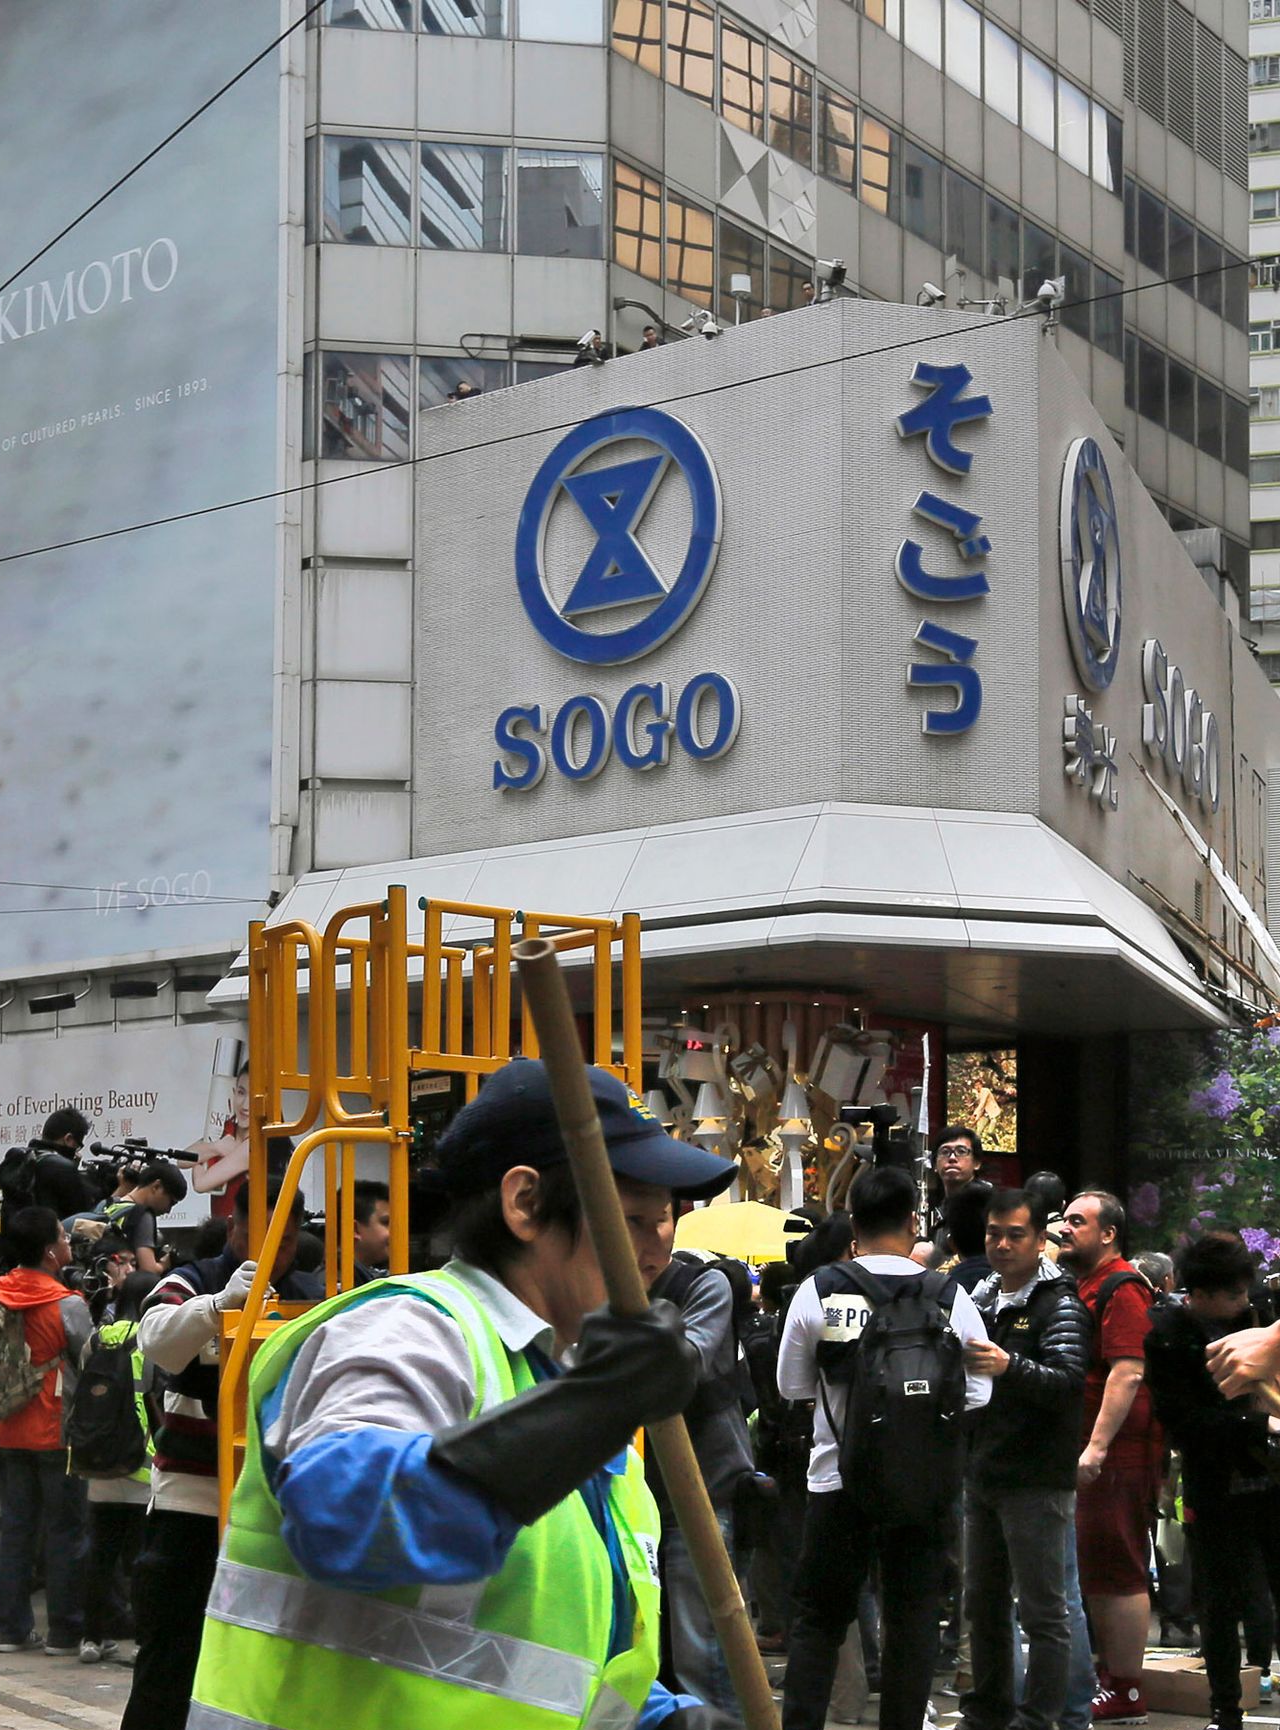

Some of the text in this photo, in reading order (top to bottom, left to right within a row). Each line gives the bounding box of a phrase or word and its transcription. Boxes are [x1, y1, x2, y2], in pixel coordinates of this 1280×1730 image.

[1, 436, 17, 452] OF
[20, 418, 76, 446] CULTURED
[134, 388, 171, 411] SINCE
[894, 360, 997, 736] そごう
[493, 672, 742, 793] SOGO
[1142, 637, 1221, 816] SOGO
[91, 868, 212, 917] 1/F SOGO
[7, 1097, 22, 1118] of
[23, 1091, 104, 1120] Everlasting
[108, 1089, 160, 1118] Beauty
